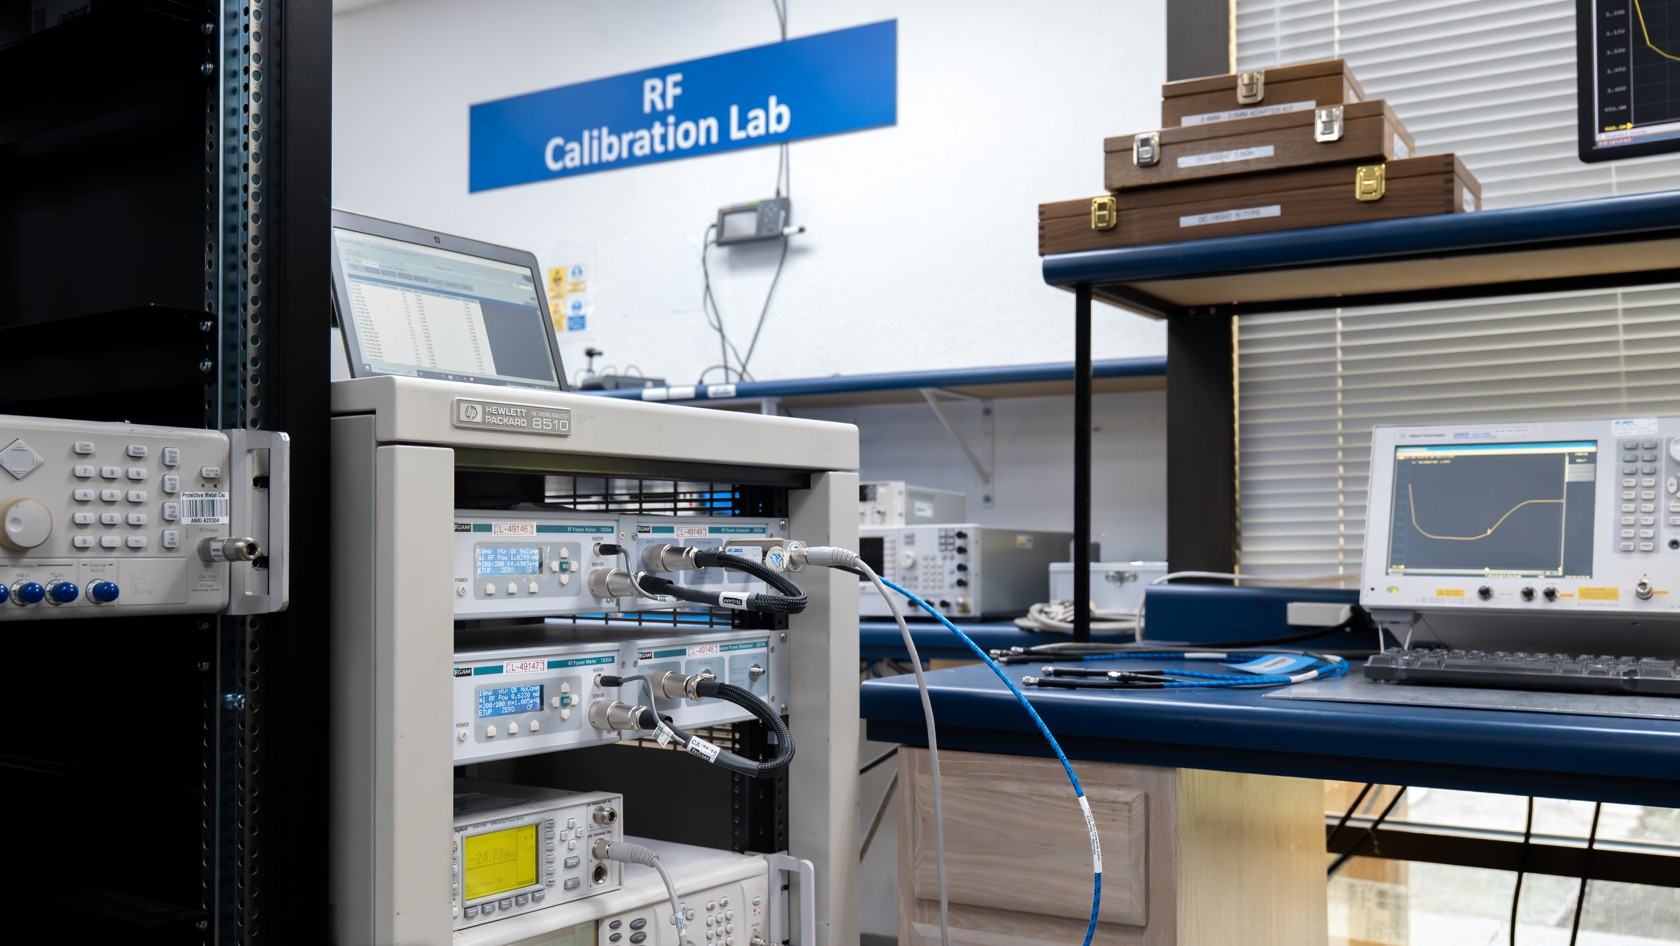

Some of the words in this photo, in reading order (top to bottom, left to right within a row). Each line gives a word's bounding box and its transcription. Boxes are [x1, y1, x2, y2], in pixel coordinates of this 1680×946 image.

[643, 72, 684, 114] RF
[544, 114, 719, 172] Calibration
[729, 94, 792, 142] Lab
[485, 405, 527, 417] HEWLETT
[532, 410, 550, 418] NETWORK
[551, 412, 569, 420] ANALYZER
[485, 416, 527, 427] PACKARD
[532, 417, 569, 431] 8510
[499, 524, 529, 533] L-49146
[500, 566, 514, 574] ZERO
[511, 661, 540, 671] L-49147
[526, 703, 534, 711] CF
[478, 709, 493, 717] ETUP
[469, 847, 504, 865] -24.73
